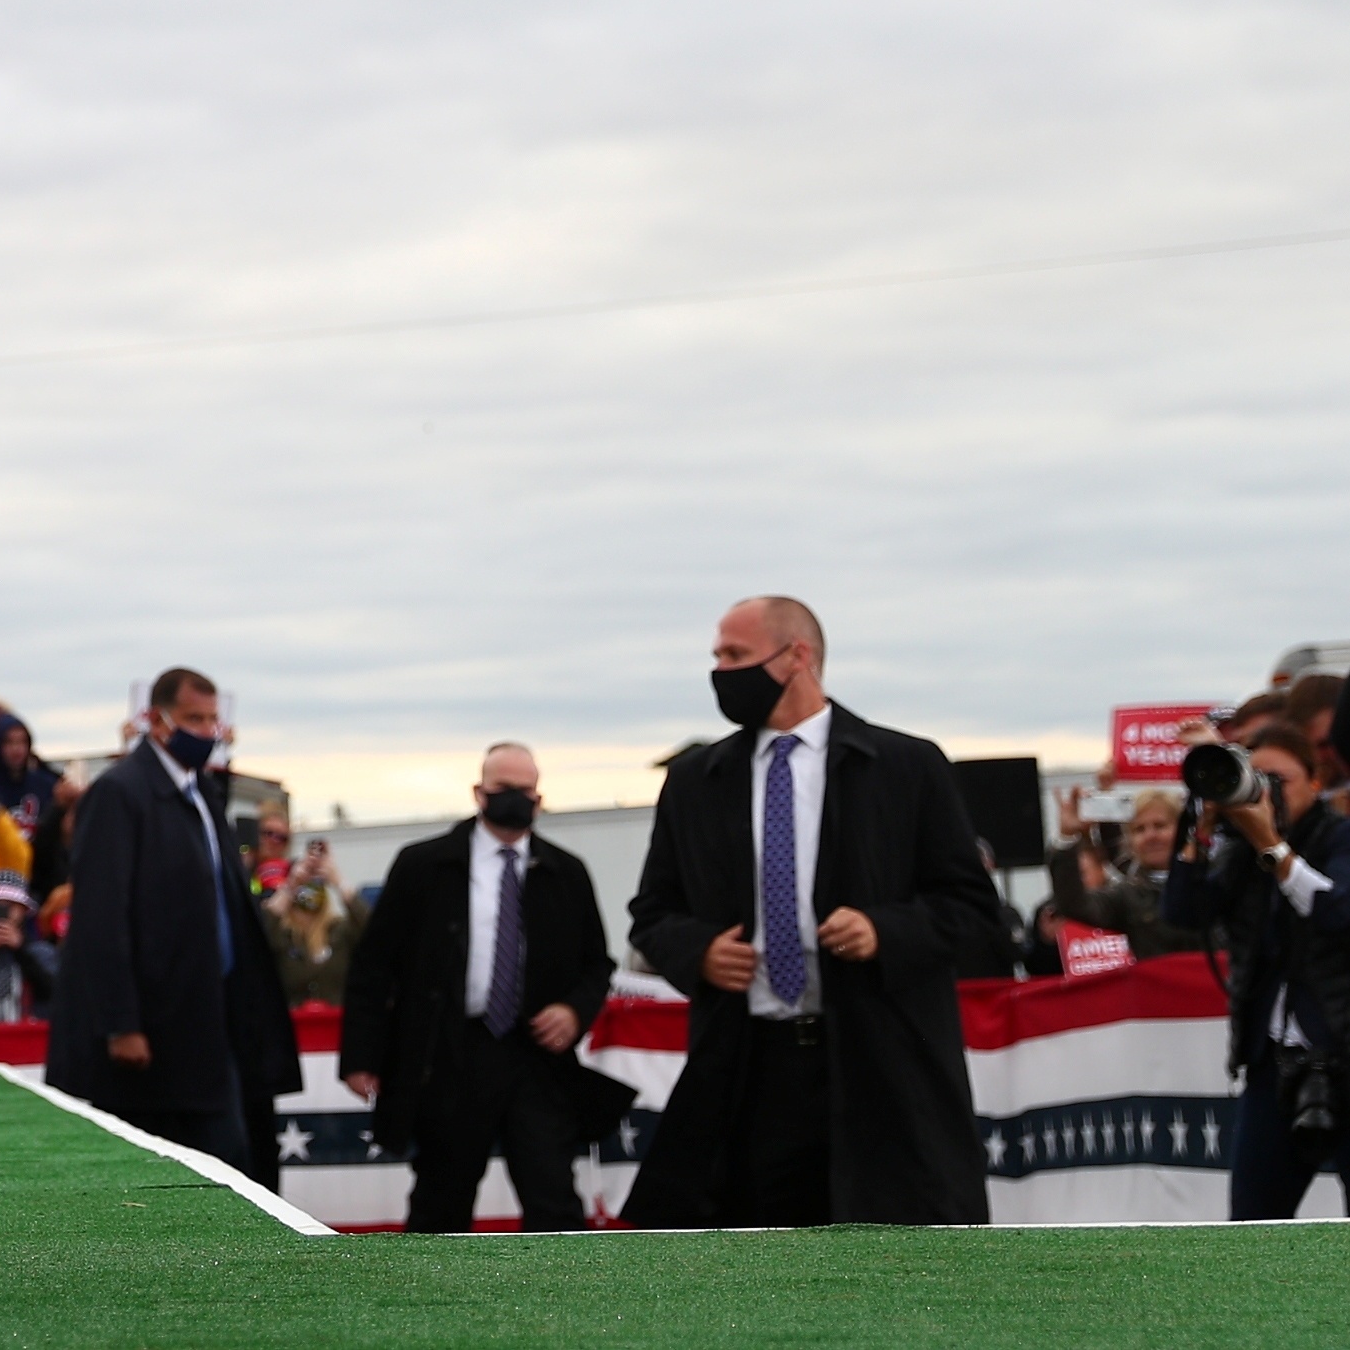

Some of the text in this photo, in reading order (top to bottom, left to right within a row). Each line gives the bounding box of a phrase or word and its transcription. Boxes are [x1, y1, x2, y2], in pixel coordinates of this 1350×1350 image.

[1121, 721, 1180, 744] 4 MO
[1122, 744, 1187, 767] YEAR
